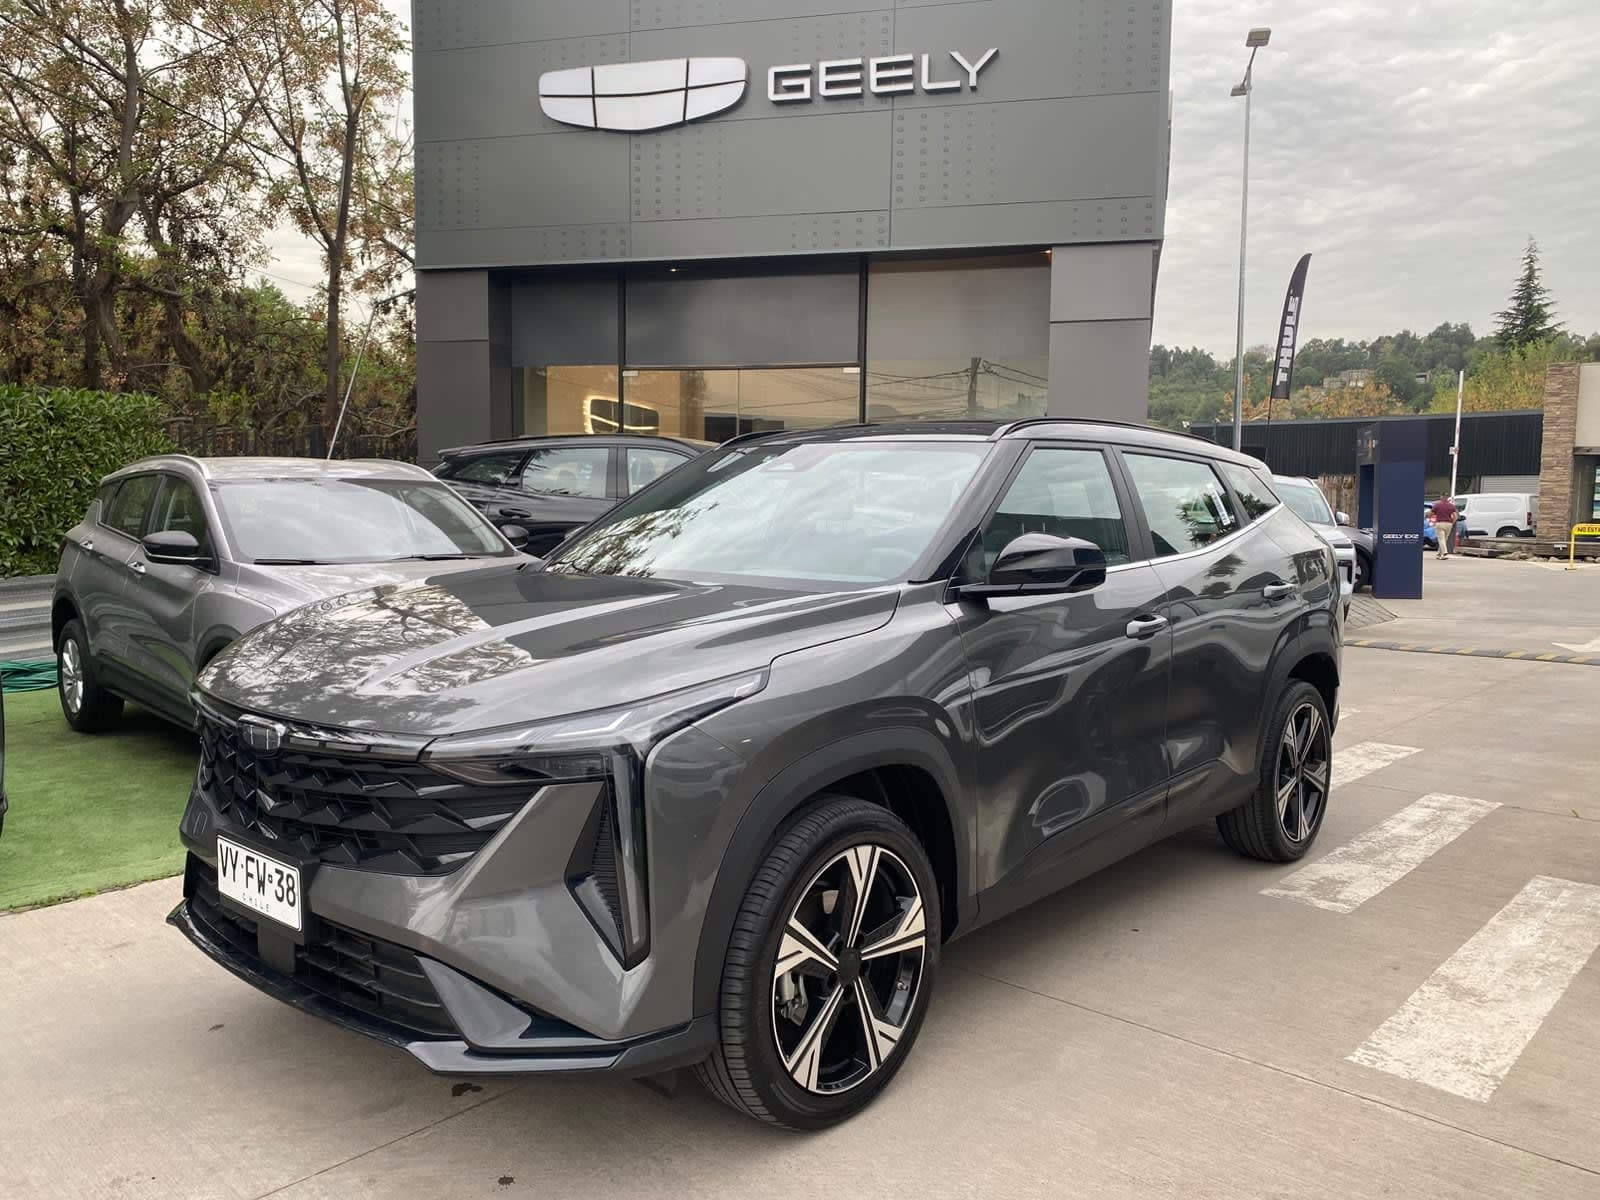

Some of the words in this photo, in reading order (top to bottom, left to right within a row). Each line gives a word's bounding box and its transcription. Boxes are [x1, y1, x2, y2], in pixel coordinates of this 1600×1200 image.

[767, 47, 1000, 102] GEELY
[1276, 296, 1299, 386] THULE
[242, 892, 270, 912] CHILE
